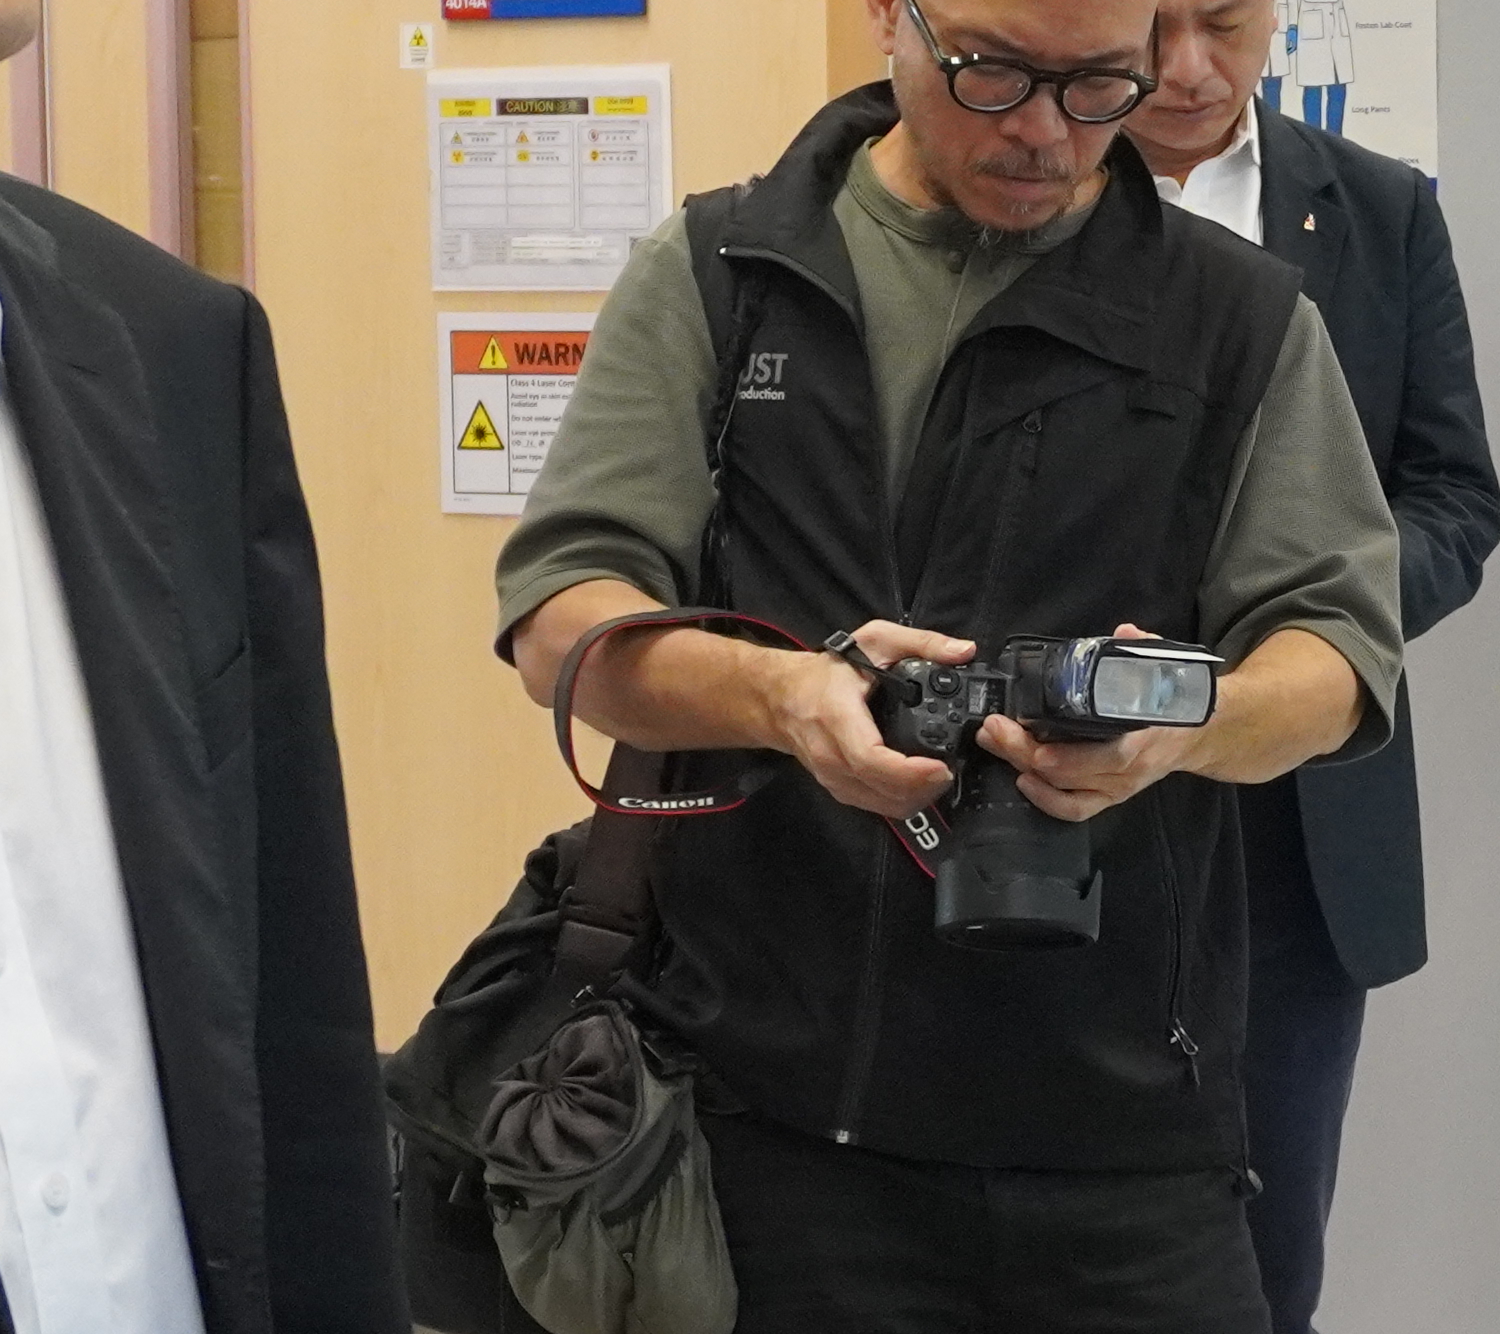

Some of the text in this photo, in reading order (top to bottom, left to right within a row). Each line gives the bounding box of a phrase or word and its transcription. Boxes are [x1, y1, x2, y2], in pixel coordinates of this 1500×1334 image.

[506, 100, 554, 113] CAUTION
[514, 342, 587, 366] WARN
[739, 385, 785, 400] oduction
[618, 797, 714, 809] Canon
